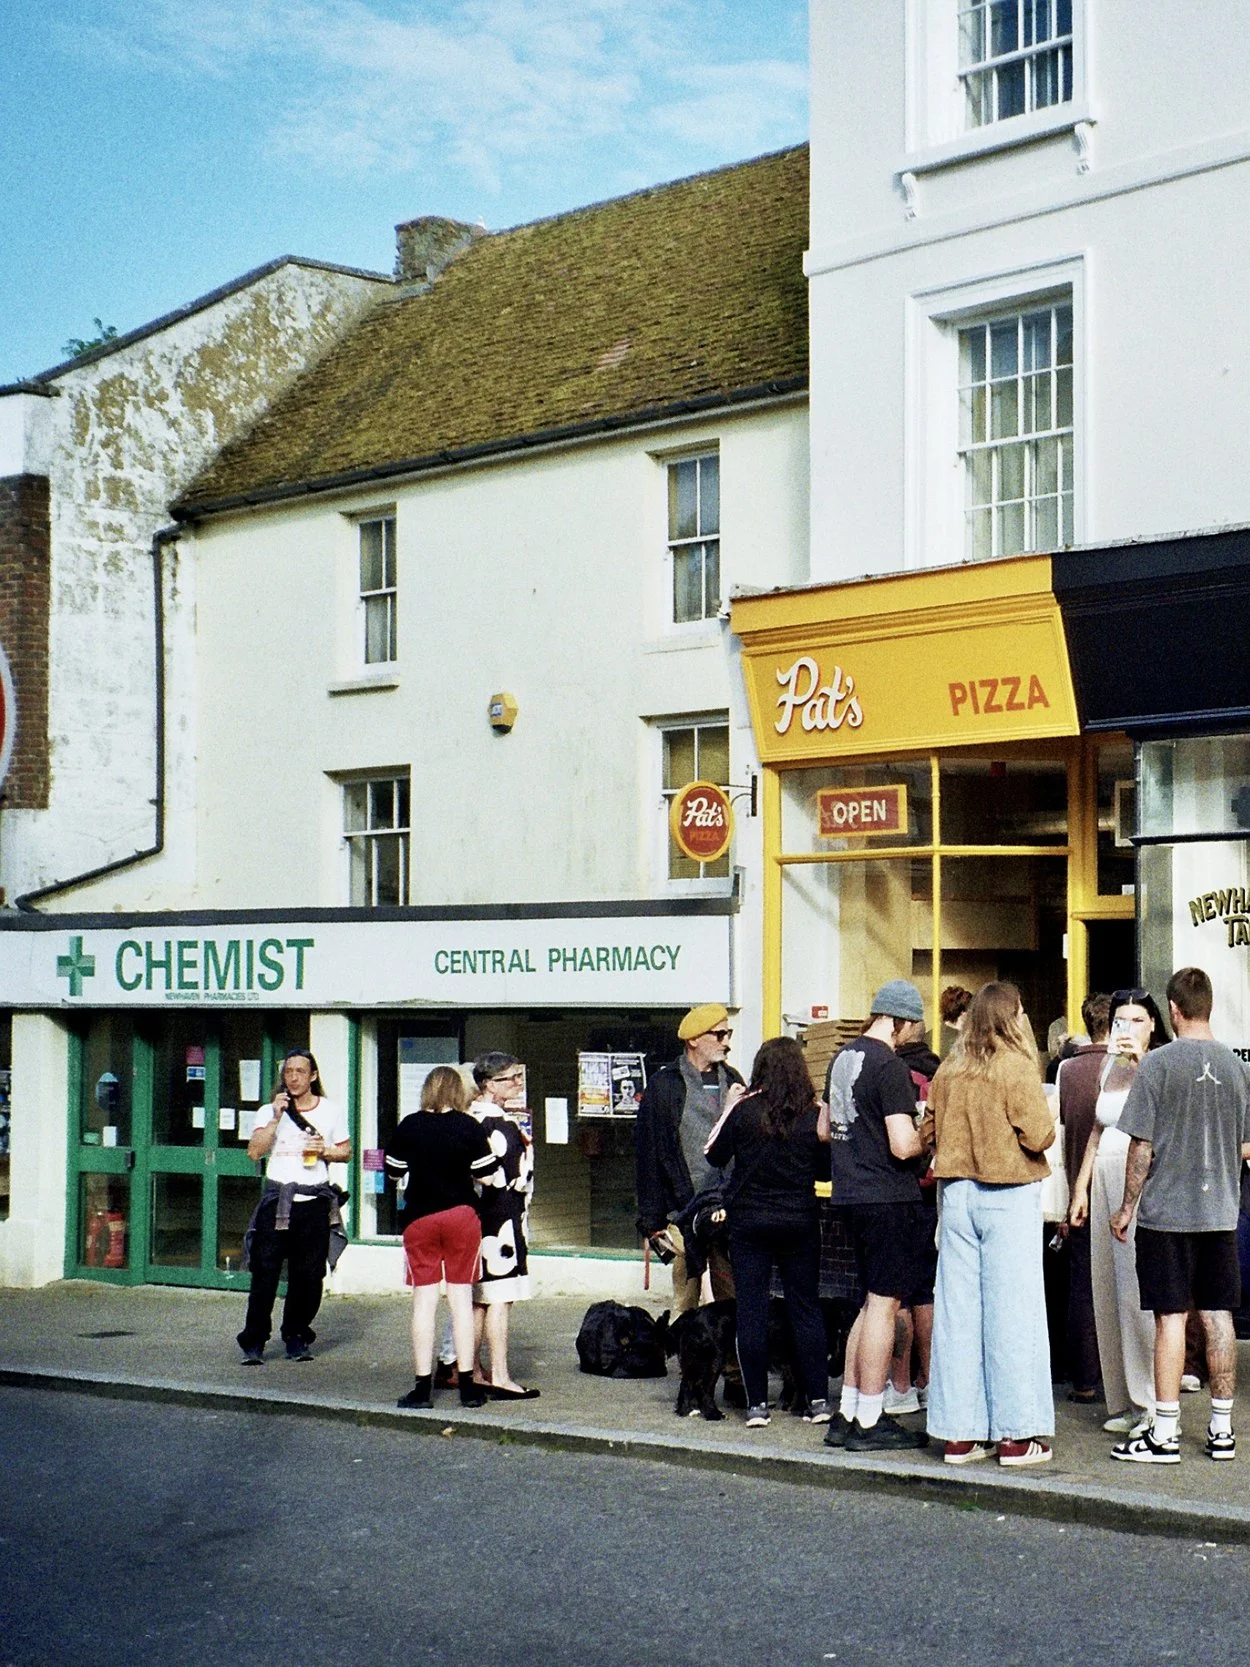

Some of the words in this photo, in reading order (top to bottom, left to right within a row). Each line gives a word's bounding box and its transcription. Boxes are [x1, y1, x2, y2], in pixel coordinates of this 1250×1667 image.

[774, 656, 864, 734] Pat's
[948, 674, 1051, 717] PIZZA
[682, 797, 725, 827] Pat's
[833, 798, 887, 825] OPEN
[690, 829, 719, 843] PIZZA
[115, 938, 315, 991] CHEMIST
[434, 949, 536, 974] CENTRAL
[548, 945, 682, 972] PHARMACY
[165, 992, 200, 1001] NEWHAVEN
[203, 992, 246, 1001] PHARMACIES
